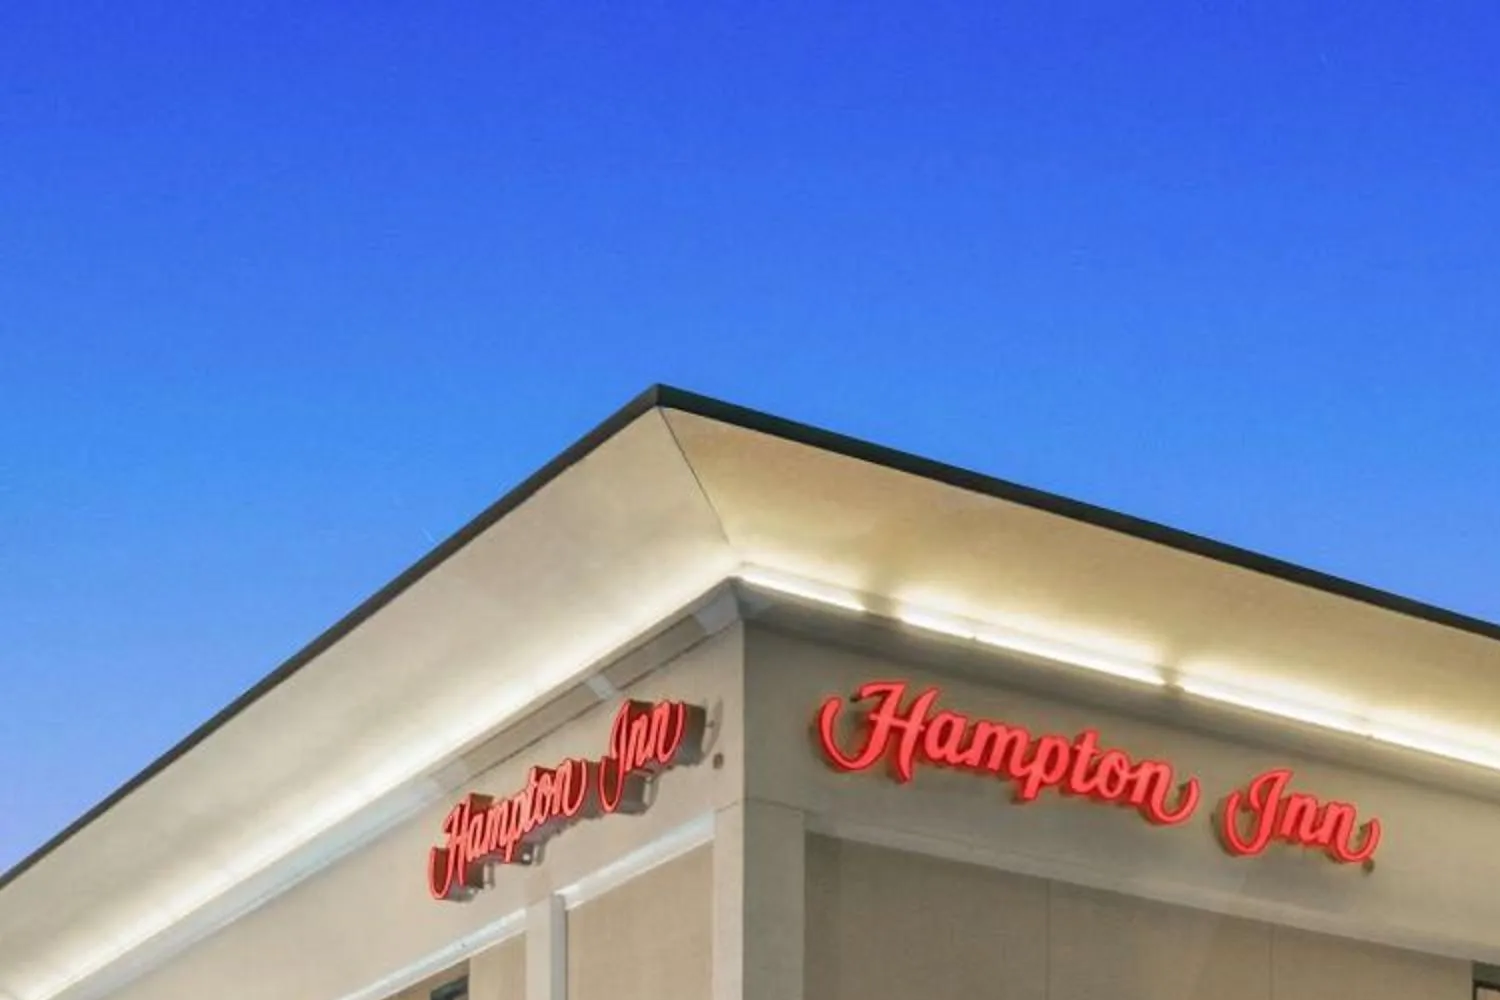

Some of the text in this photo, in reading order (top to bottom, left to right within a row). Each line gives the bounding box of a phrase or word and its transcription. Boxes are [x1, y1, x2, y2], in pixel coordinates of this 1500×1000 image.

[427, 698, 687, 900] Hampton Inn
[817, 680, 1382, 864] Hampton Inn
